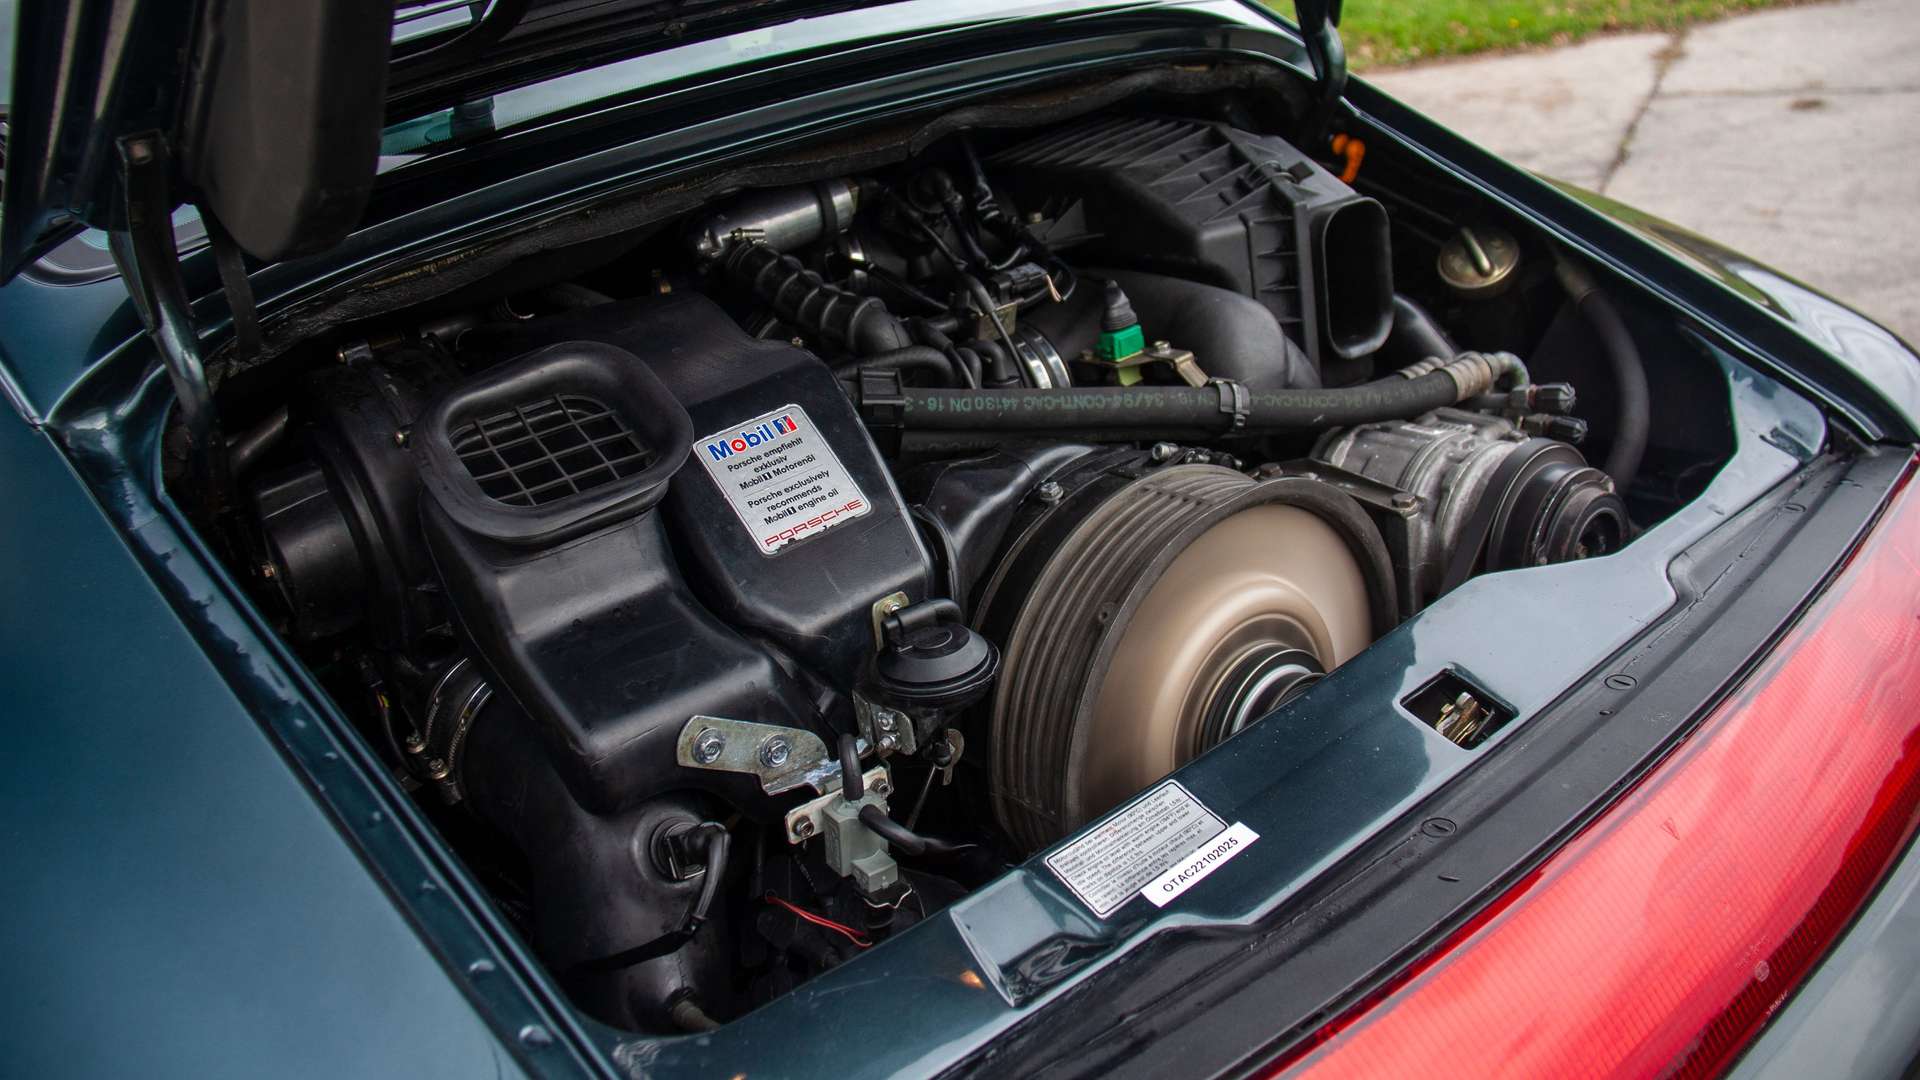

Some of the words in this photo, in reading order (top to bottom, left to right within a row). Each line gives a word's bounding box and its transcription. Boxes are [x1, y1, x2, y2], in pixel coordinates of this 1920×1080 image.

[950, 396, 972, 411] DN
[707, 424, 774, 461] Mobil
[727, 454, 763, 473] Porsche
[764, 437, 804, 459] empfiehlt
[753, 455, 788, 473] exklusiv
[773, 454, 816, 477] Motorenöl
[747, 490, 783, 509] Porsche
[784, 469, 831, 494] exclusively
[767, 484, 823, 513] recommends
[798, 494, 827, 511] engine
[828, 487, 839, 499] oil
[765, 499, 864, 547] PORSCHE
[1162, 837, 1239, 892] OTAC22102025
